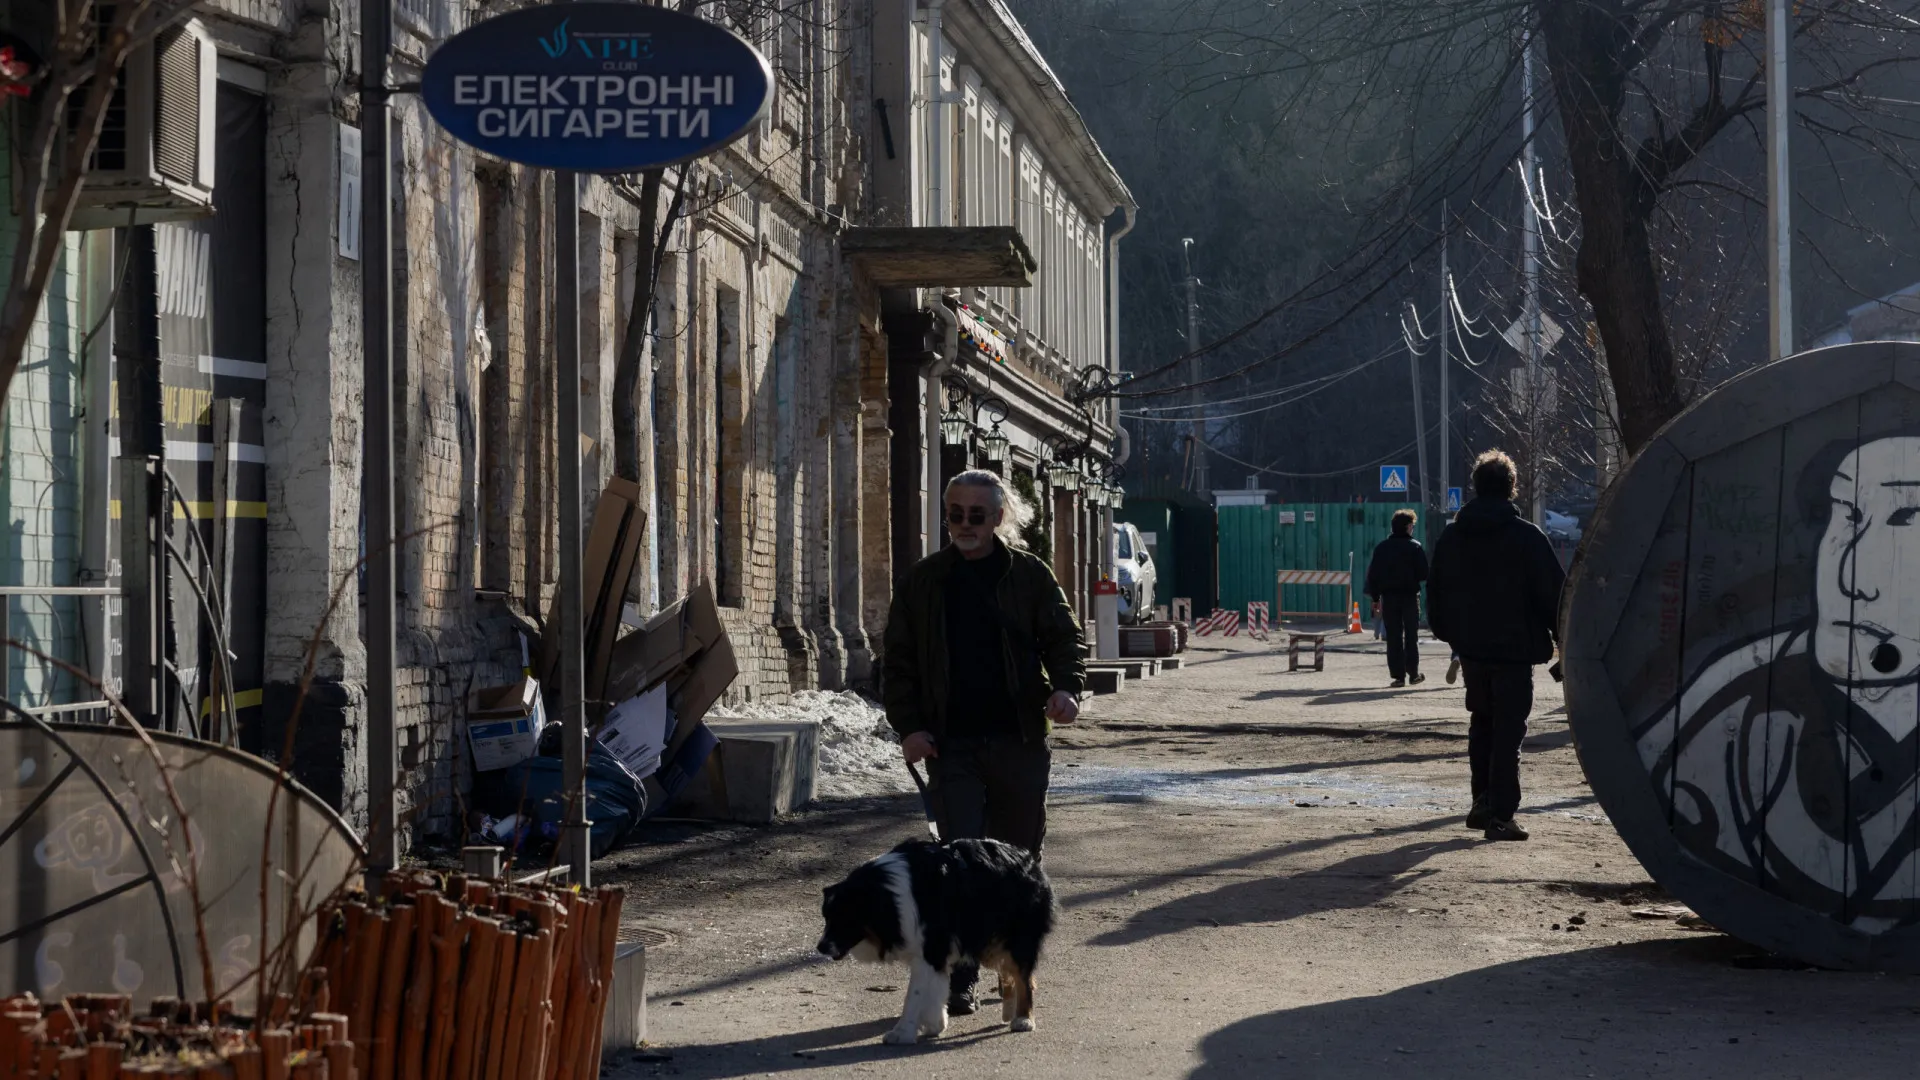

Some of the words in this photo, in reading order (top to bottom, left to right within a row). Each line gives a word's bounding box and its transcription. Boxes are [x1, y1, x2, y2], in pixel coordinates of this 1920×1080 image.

[538, 19, 656, 59] VAPE
[603, 61, 638, 71] CLUB
[453, 75, 734, 105] ЕЛЕКТРОННІ
[477, 108, 709, 138] СИГАРЕТИ
